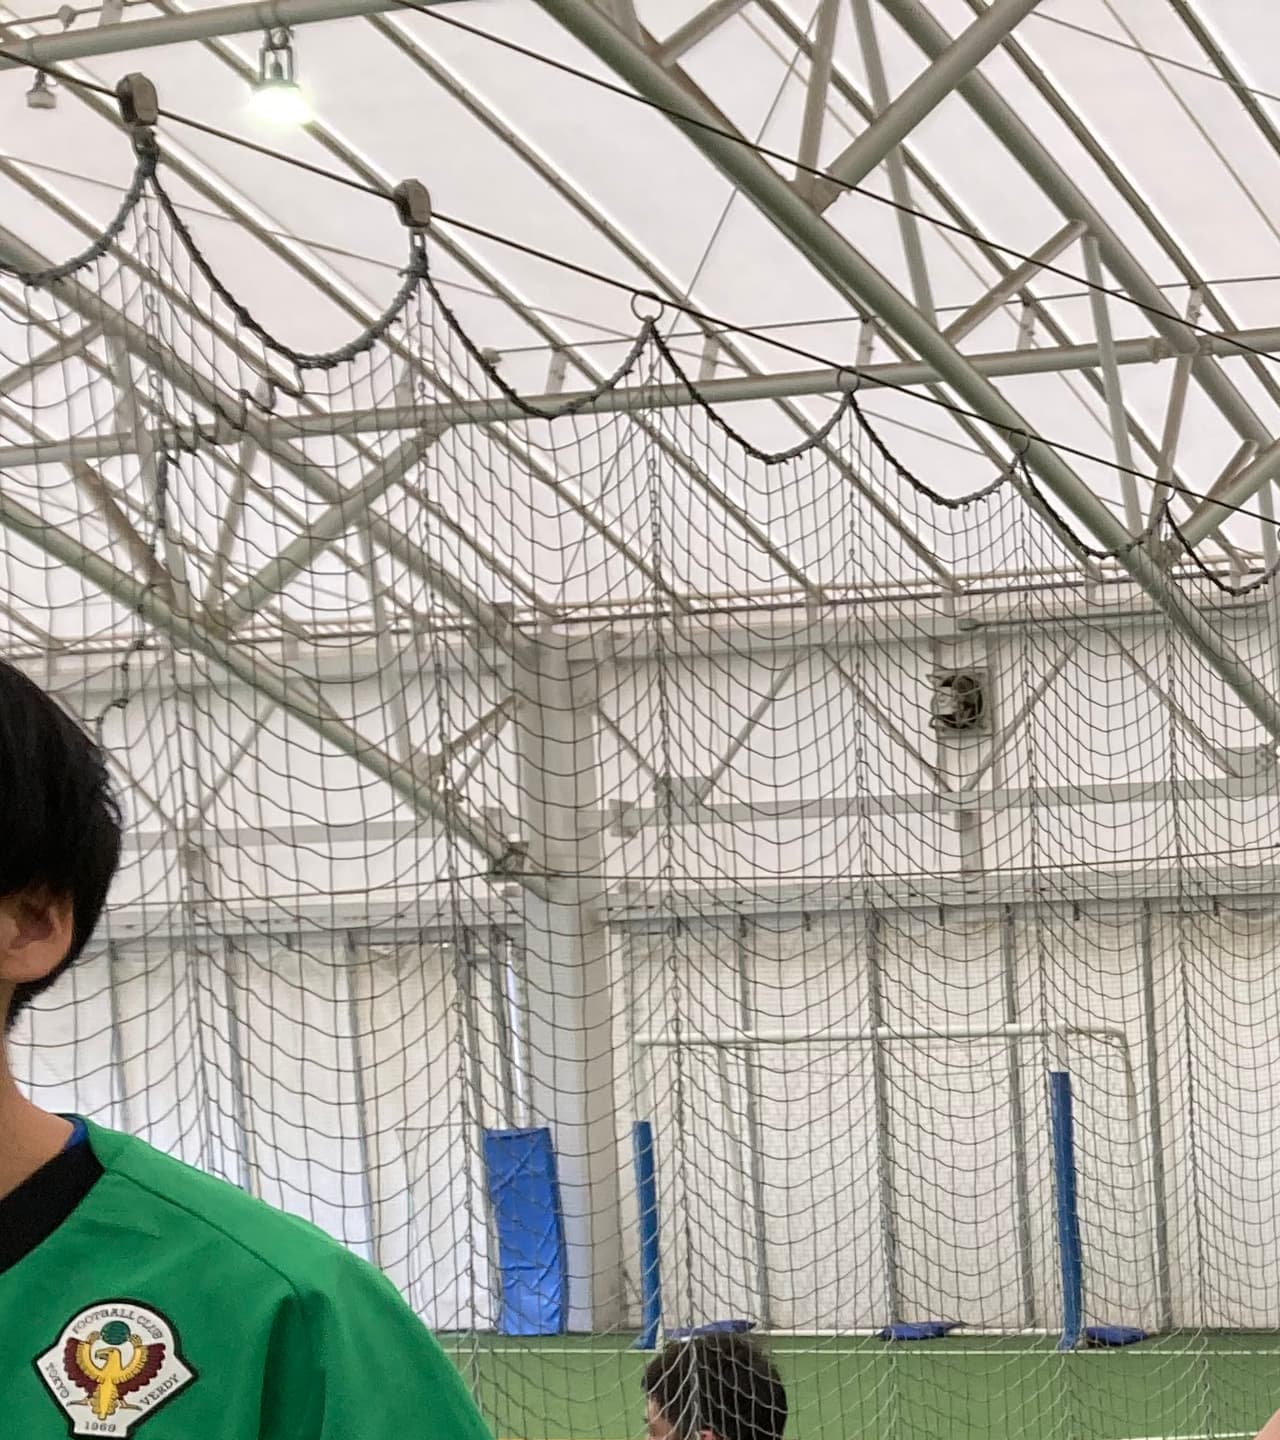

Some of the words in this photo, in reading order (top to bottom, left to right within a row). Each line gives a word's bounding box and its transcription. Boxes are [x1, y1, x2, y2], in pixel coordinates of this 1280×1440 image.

[72, 1308, 136, 1334] FOOTBALL
[137, 1315, 163, 1339] CLUB
[45, 1362, 70, 1399] TOKYO
[139, 1373, 182, 1406] VERDY
